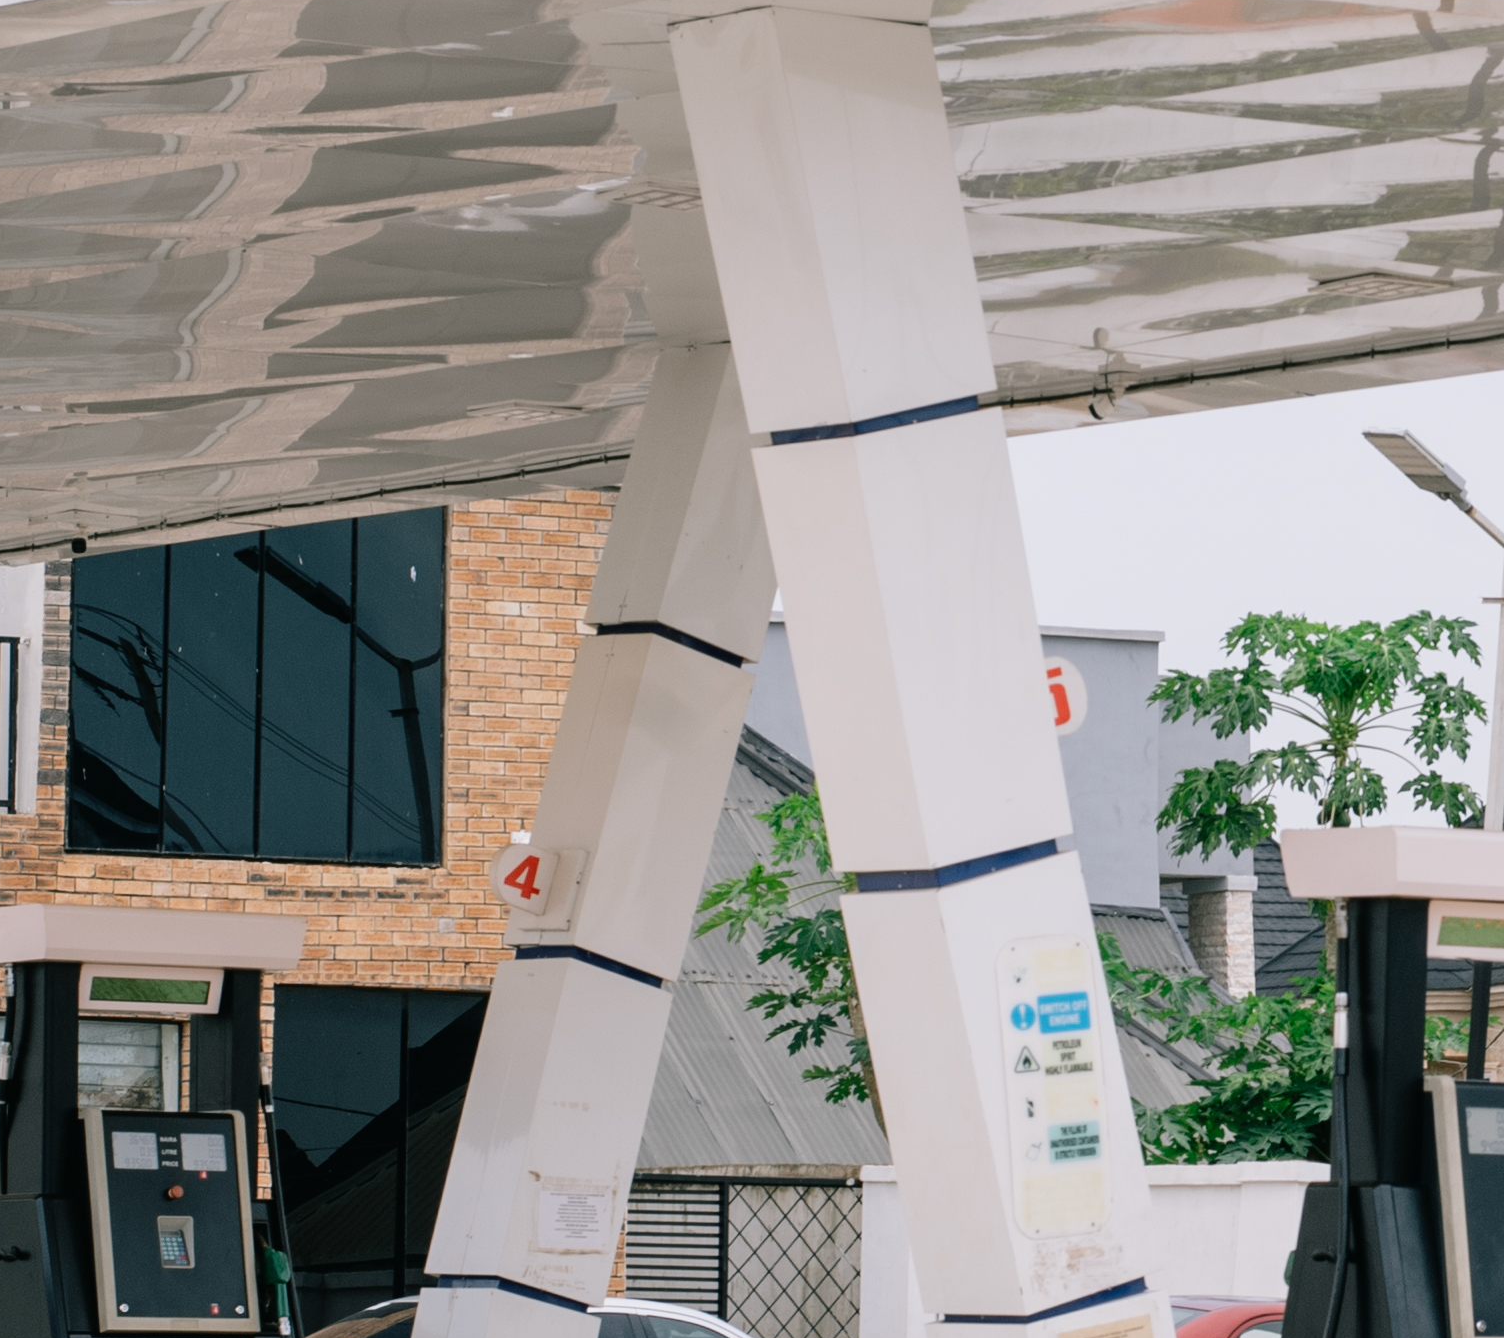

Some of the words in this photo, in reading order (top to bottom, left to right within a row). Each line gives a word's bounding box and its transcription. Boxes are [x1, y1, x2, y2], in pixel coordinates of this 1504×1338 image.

[503, 855, 540, 900] 4
[1039, 1002, 1071, 1015] SWITCH
[1072, 1000, 1087, 1011] OFF
